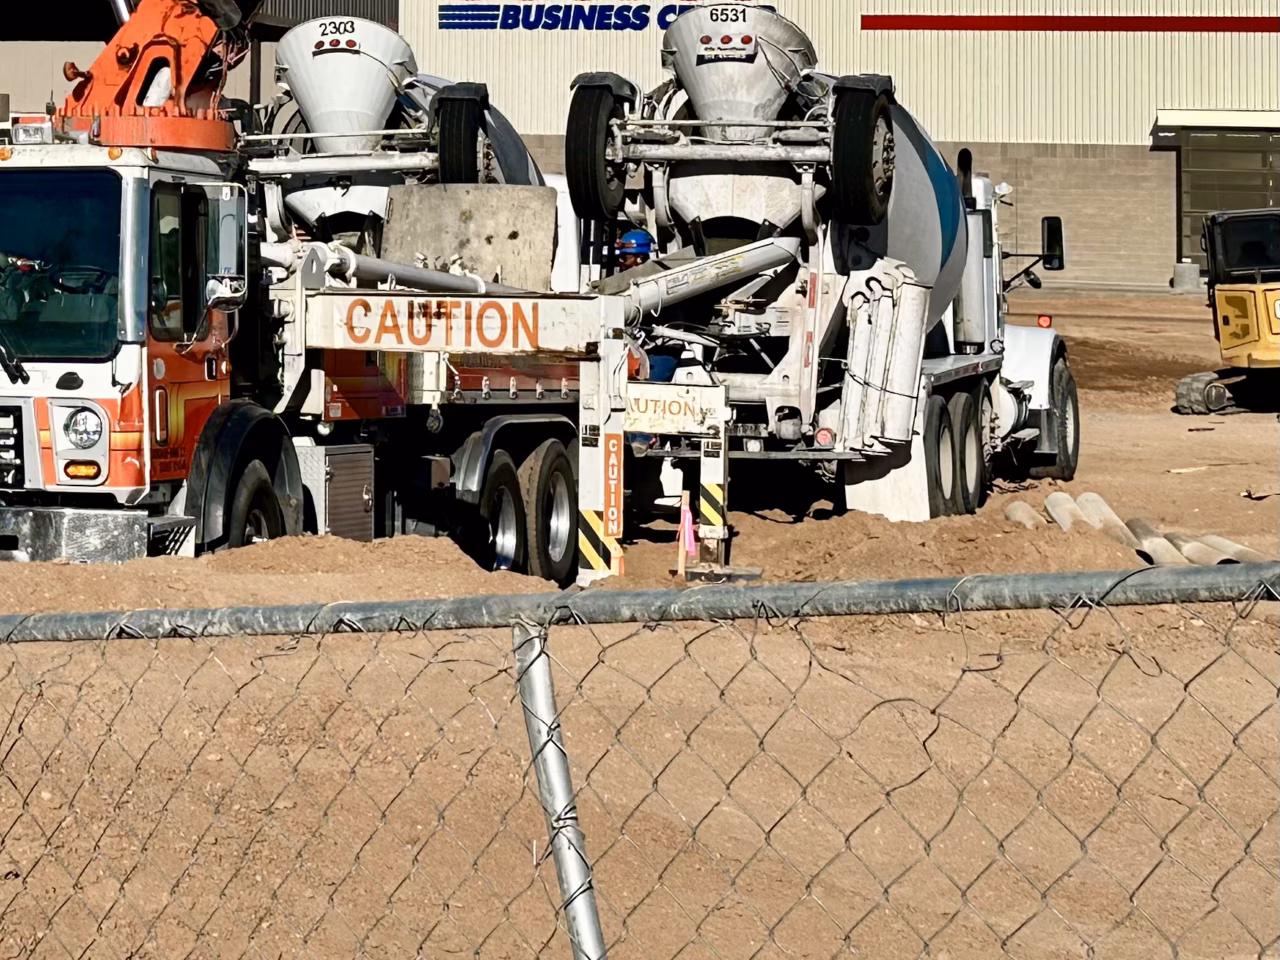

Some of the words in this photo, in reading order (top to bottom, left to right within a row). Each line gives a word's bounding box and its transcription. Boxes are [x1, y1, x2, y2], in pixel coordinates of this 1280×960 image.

[499, 4, 651, 31] BUSINESS
[709, 7, 747, 23] 6531
[319, 20, 356, 37] 2303
[345, 298, 539, 349] CAUTION
[628, 397, 696, 417] AUTION
[607, 439, 619, 534] CAUTION
